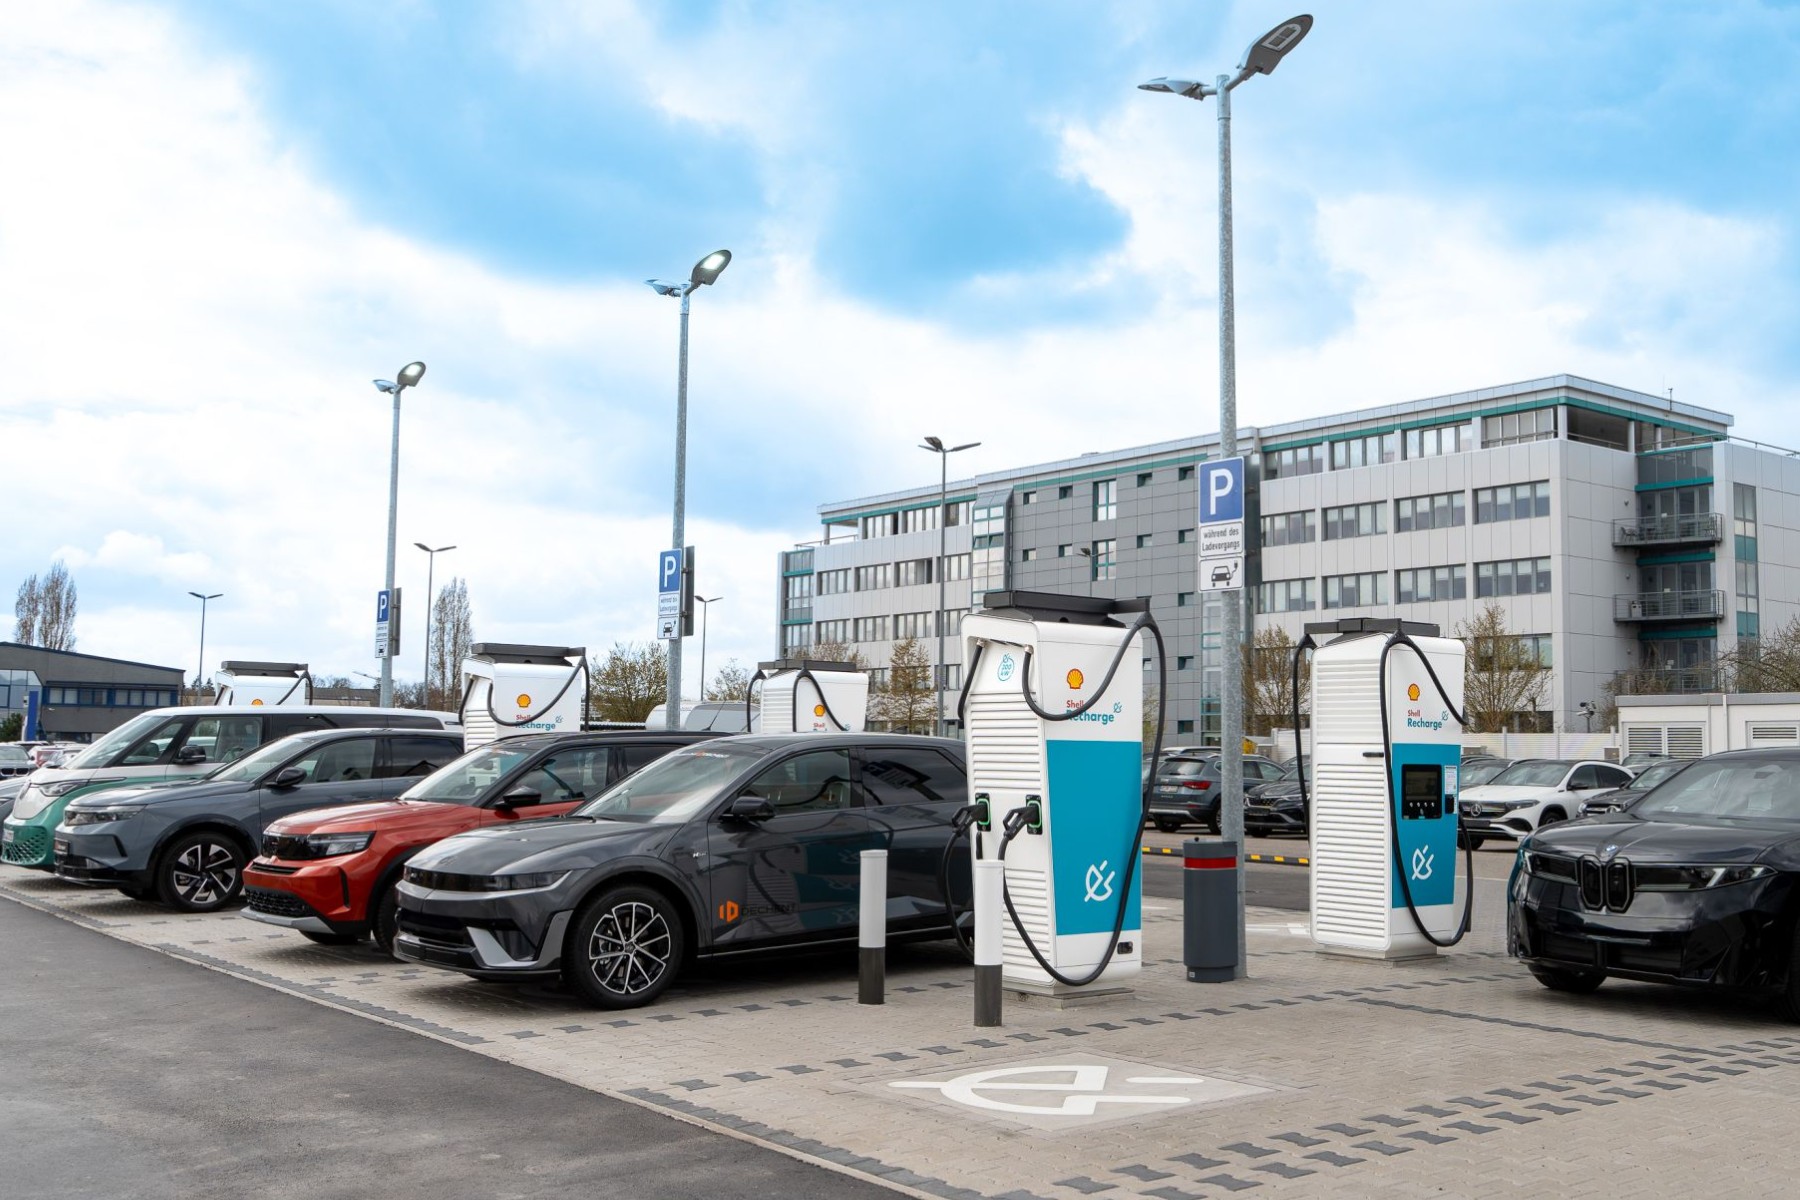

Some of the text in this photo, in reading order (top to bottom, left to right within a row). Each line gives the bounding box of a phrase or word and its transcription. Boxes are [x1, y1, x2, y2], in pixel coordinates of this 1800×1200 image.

[1210, 468, 1234, 515] P
[1203, 527, 1239, 538] während des
[1202, 541, 1240, 551] Ladevorgangs
[664, 556, 676, 587] P
[379, 595, 387, 618] P
[1066, 700, 1084, 708] Shell
[1408, 709, 1420, 717] Shell
[1407, 717, 1442, 730] Recharge
